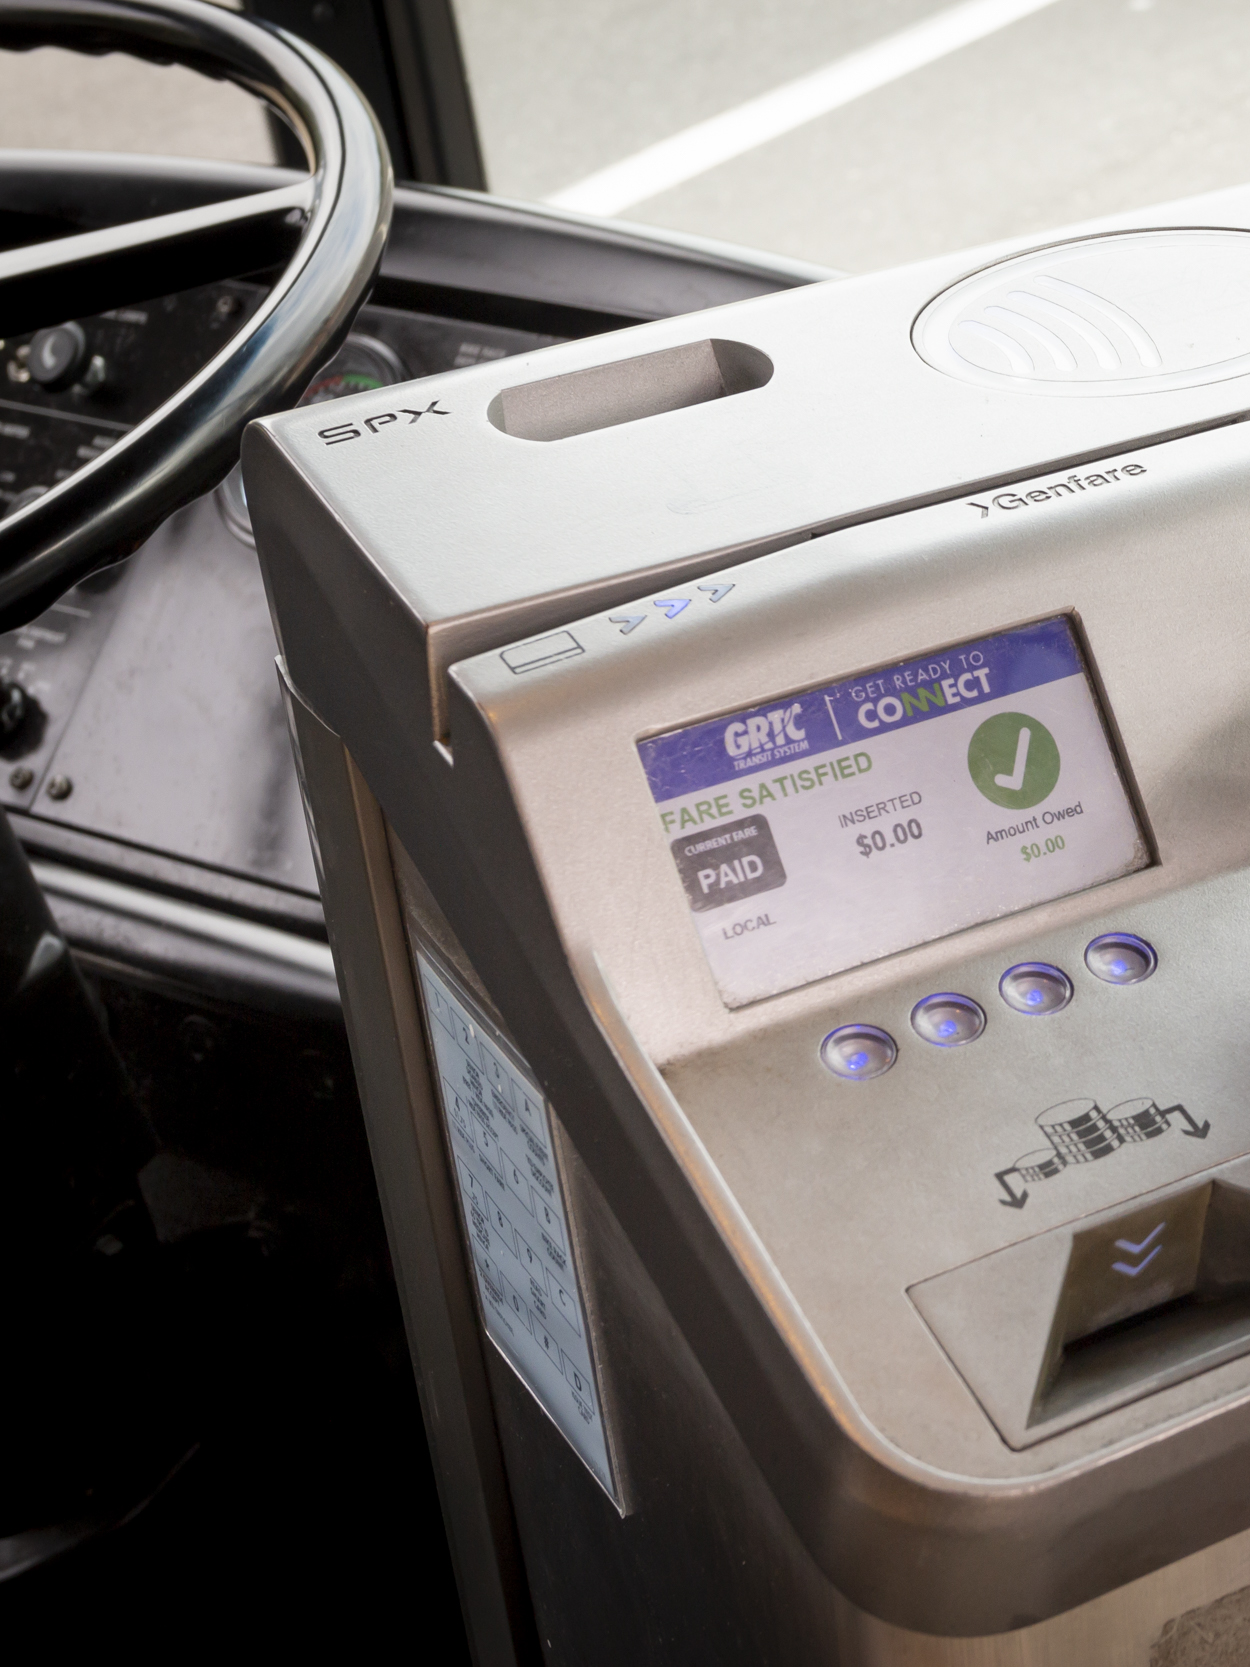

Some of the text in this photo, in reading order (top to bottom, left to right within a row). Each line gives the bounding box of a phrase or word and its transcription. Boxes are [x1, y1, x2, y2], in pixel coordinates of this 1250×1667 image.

[317, 399, 452, 446] SPX
[850, 650, 984, 702] GET READY TO
[857, 667, 991, 729] CONNECT
[724, 703, 807, 759] GRTC
[733, 739, 810, 771] TRANSIT SYSTEM
[660, 751, 873, 833] FARE SATISFIED
[838, 790, 923, 828] INSERTED
[684, 825, 759, 857] CURRENT FARE
[855, 818, 923, 858] $0.00
[986, 801, 1084, 845] Amount Owed
[1020, 834, 1065, 863] $0.00
[697, 854, 764, 894] PAID
[722, 913, 777, 940] LOCAL
